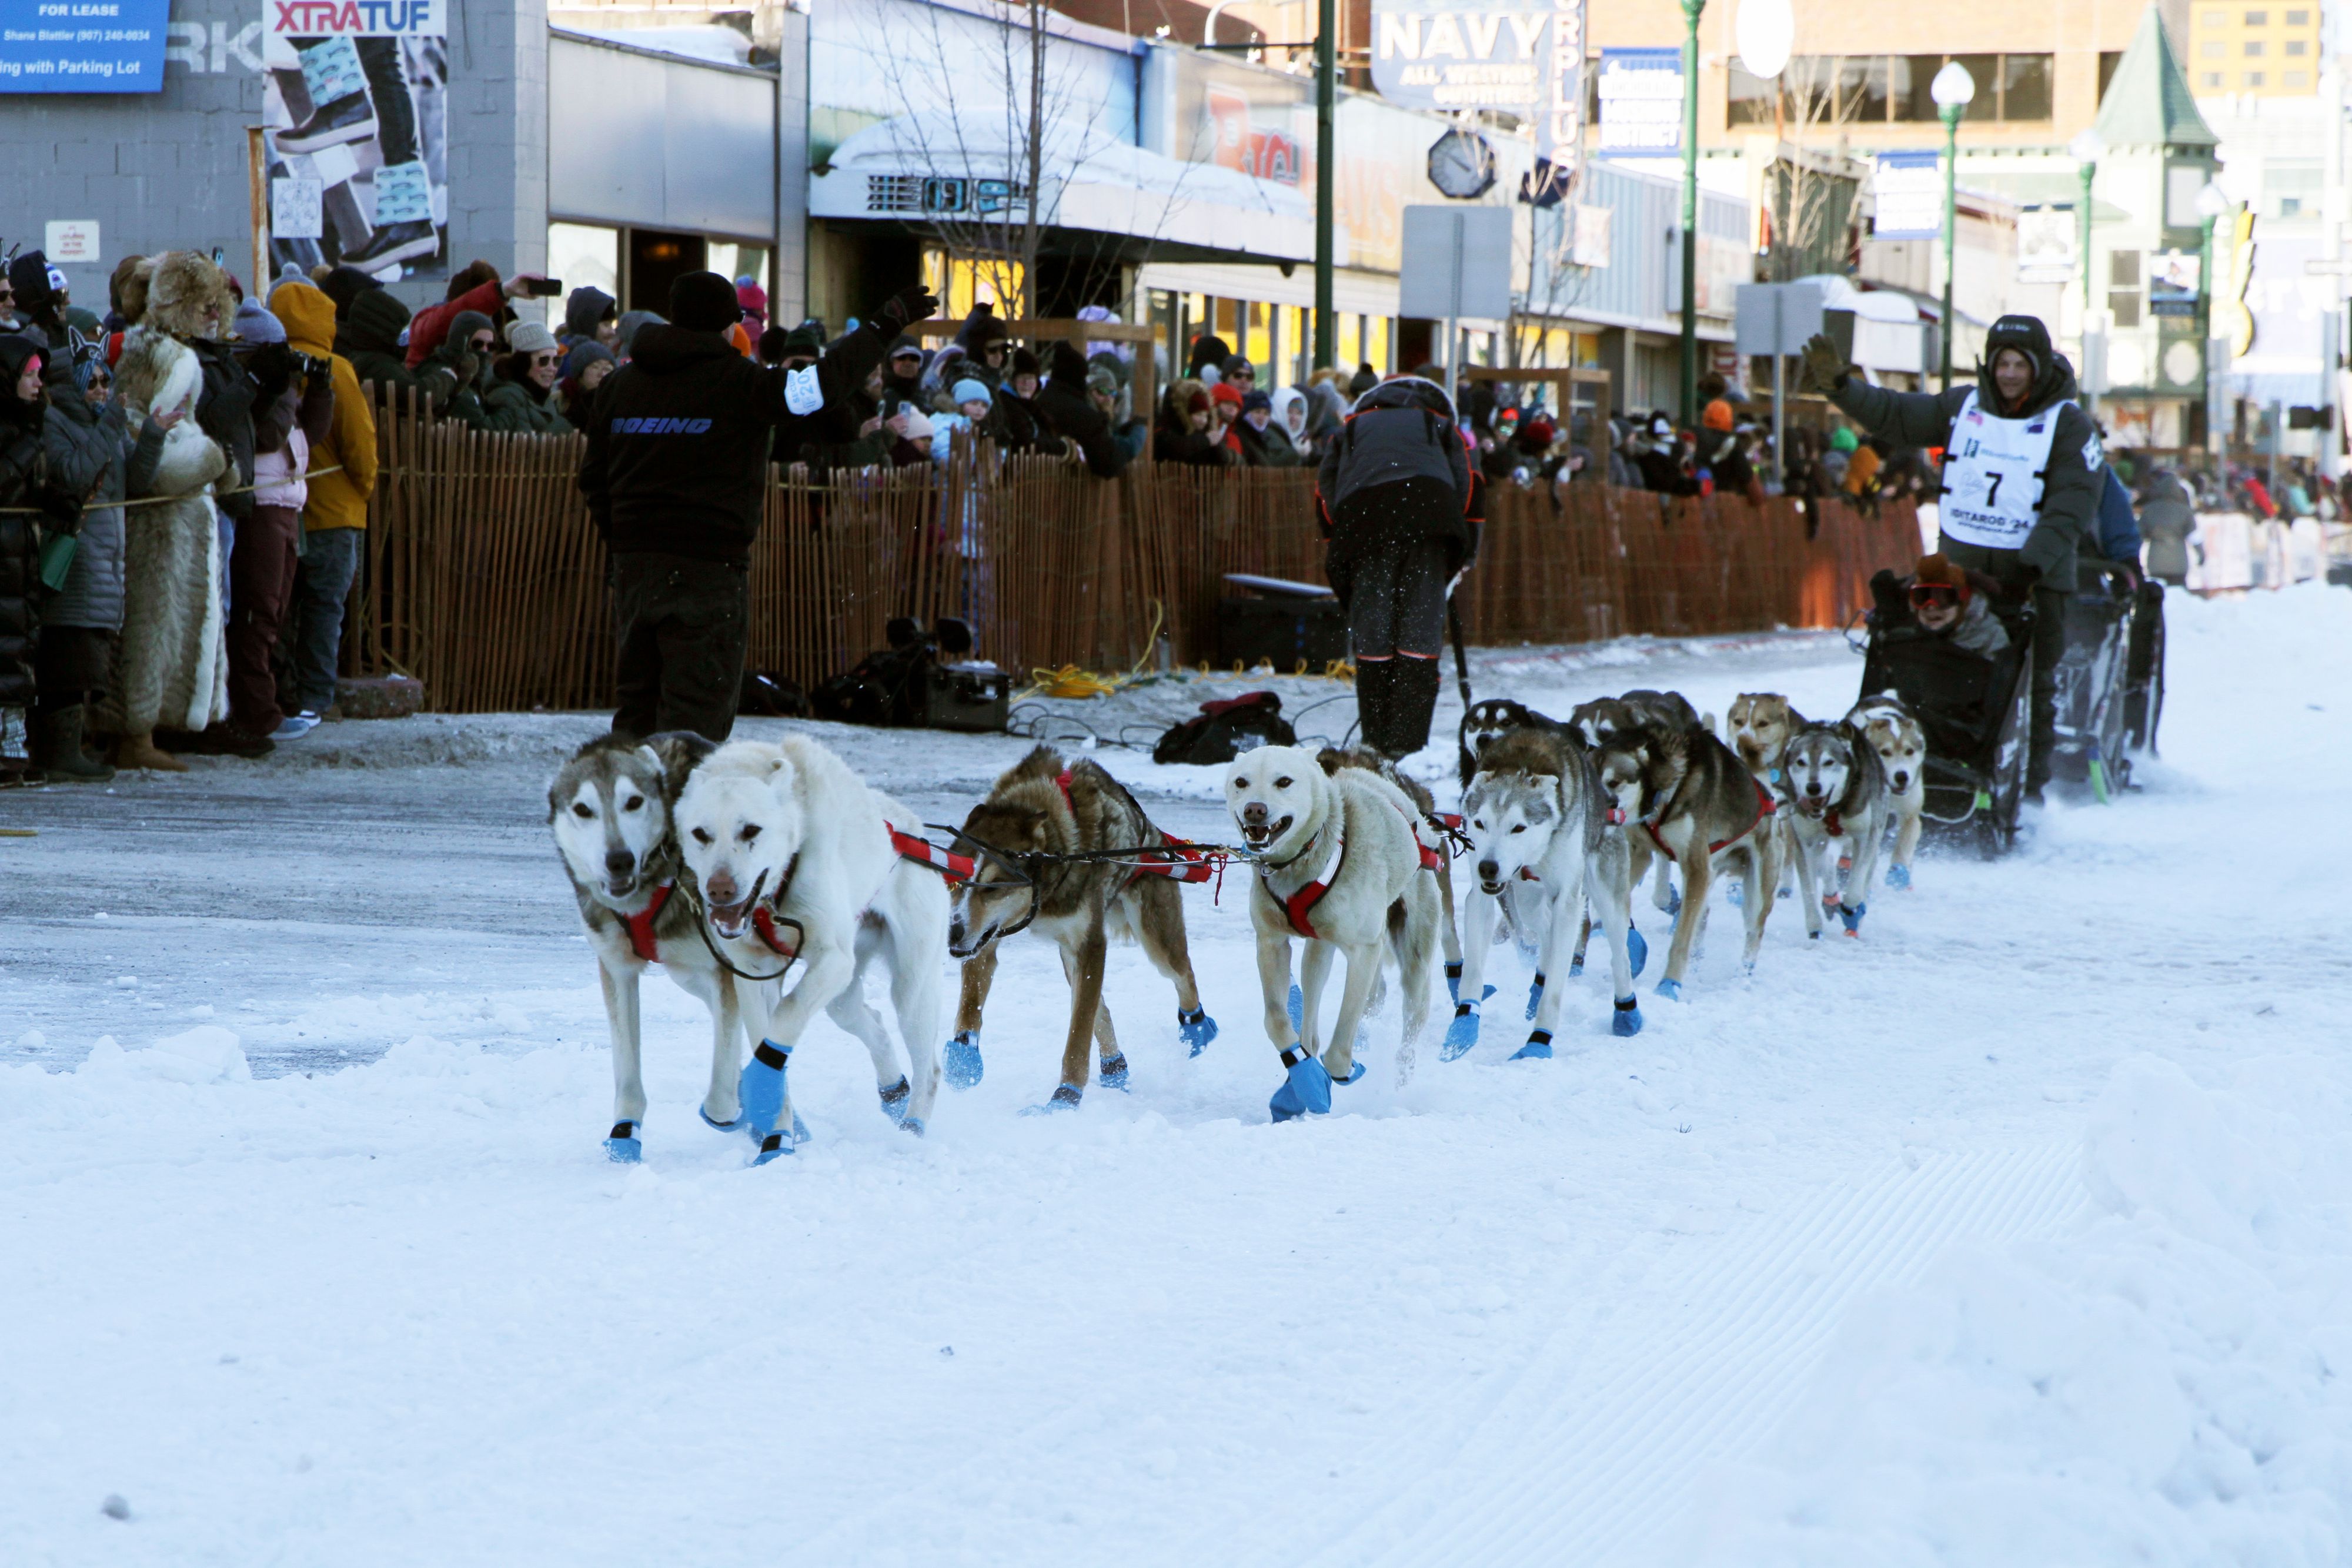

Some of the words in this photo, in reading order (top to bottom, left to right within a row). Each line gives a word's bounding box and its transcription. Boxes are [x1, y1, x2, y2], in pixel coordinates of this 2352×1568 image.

[39, 4, 68, 16] FOR
[72, 4, 119, 16] LEASE
[274, 1, 429, 32] XTRATUF
[4, 29, 36, 41] Shane
[76, 29, 102, 43] (907)
[1379, 12, 1549, 60] NAVY
[0, 61, 21, 77] ing
[25, 60, 54, 75] with
[58, 60, 113, 77] Parking
[116, 60, 141, 75] Lot
[1399, 64, 1442, 86] ALL
[1551, 0, 1581, 170] RPLUS
[611, 417, 713, 434] BOEING
[1986, 472, 2003, 507] 7
